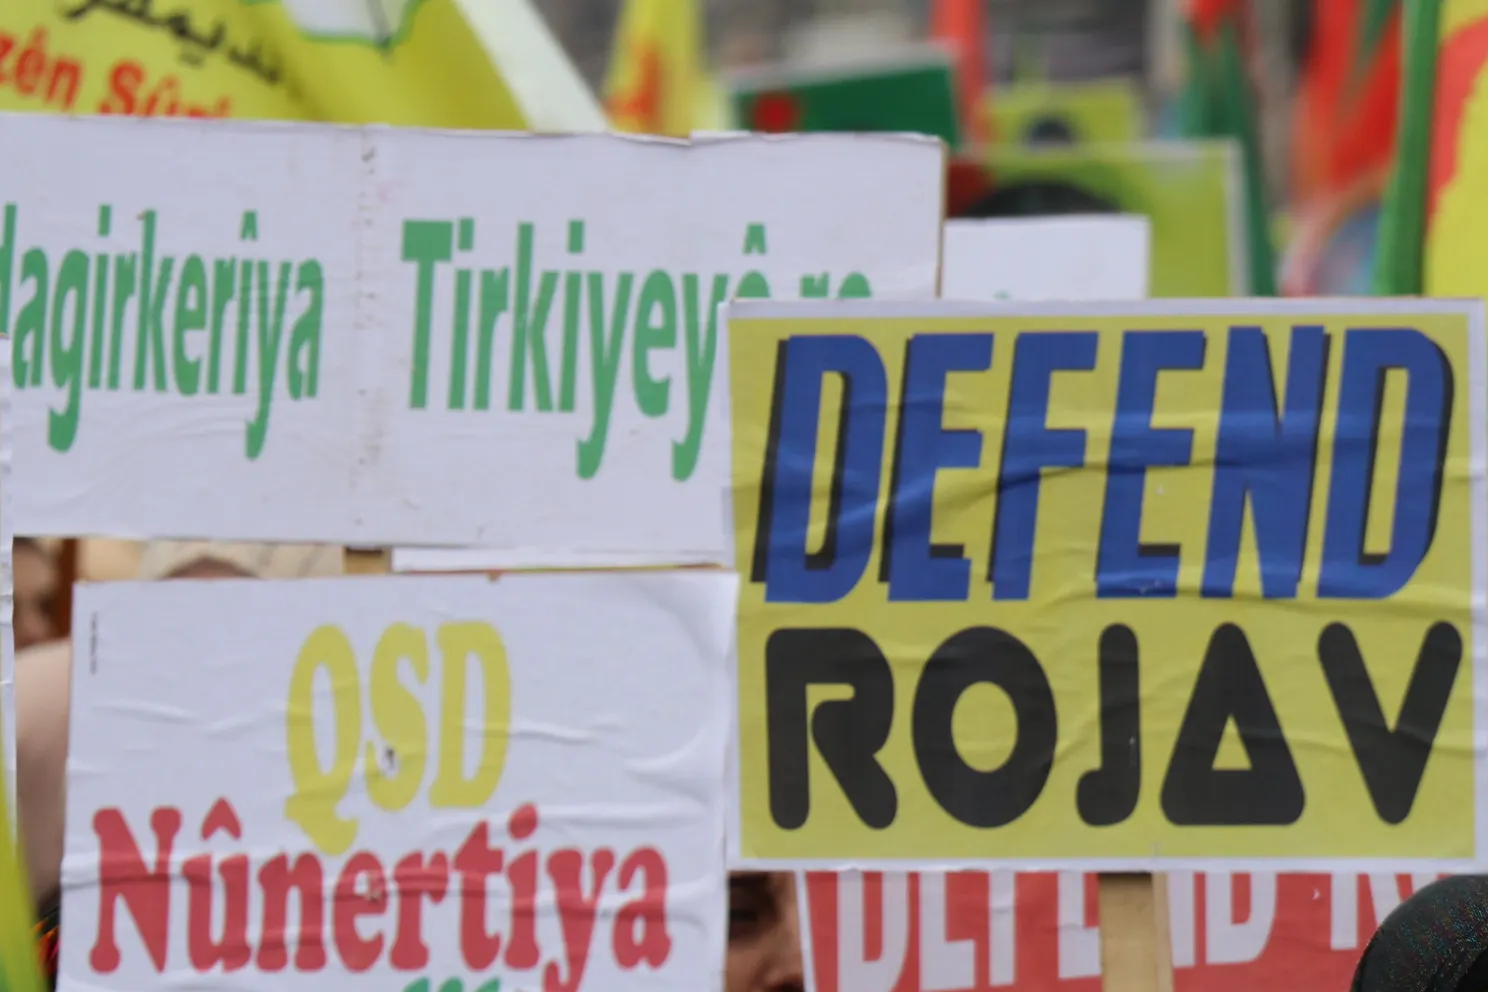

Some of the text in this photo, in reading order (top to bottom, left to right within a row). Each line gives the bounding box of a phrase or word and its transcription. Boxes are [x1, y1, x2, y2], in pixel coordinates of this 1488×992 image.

[751, 325, 1455, 603] DEFEND
[283, 620, 511, 856] QSD
[765, 621, 1464, 831] ROJAV
